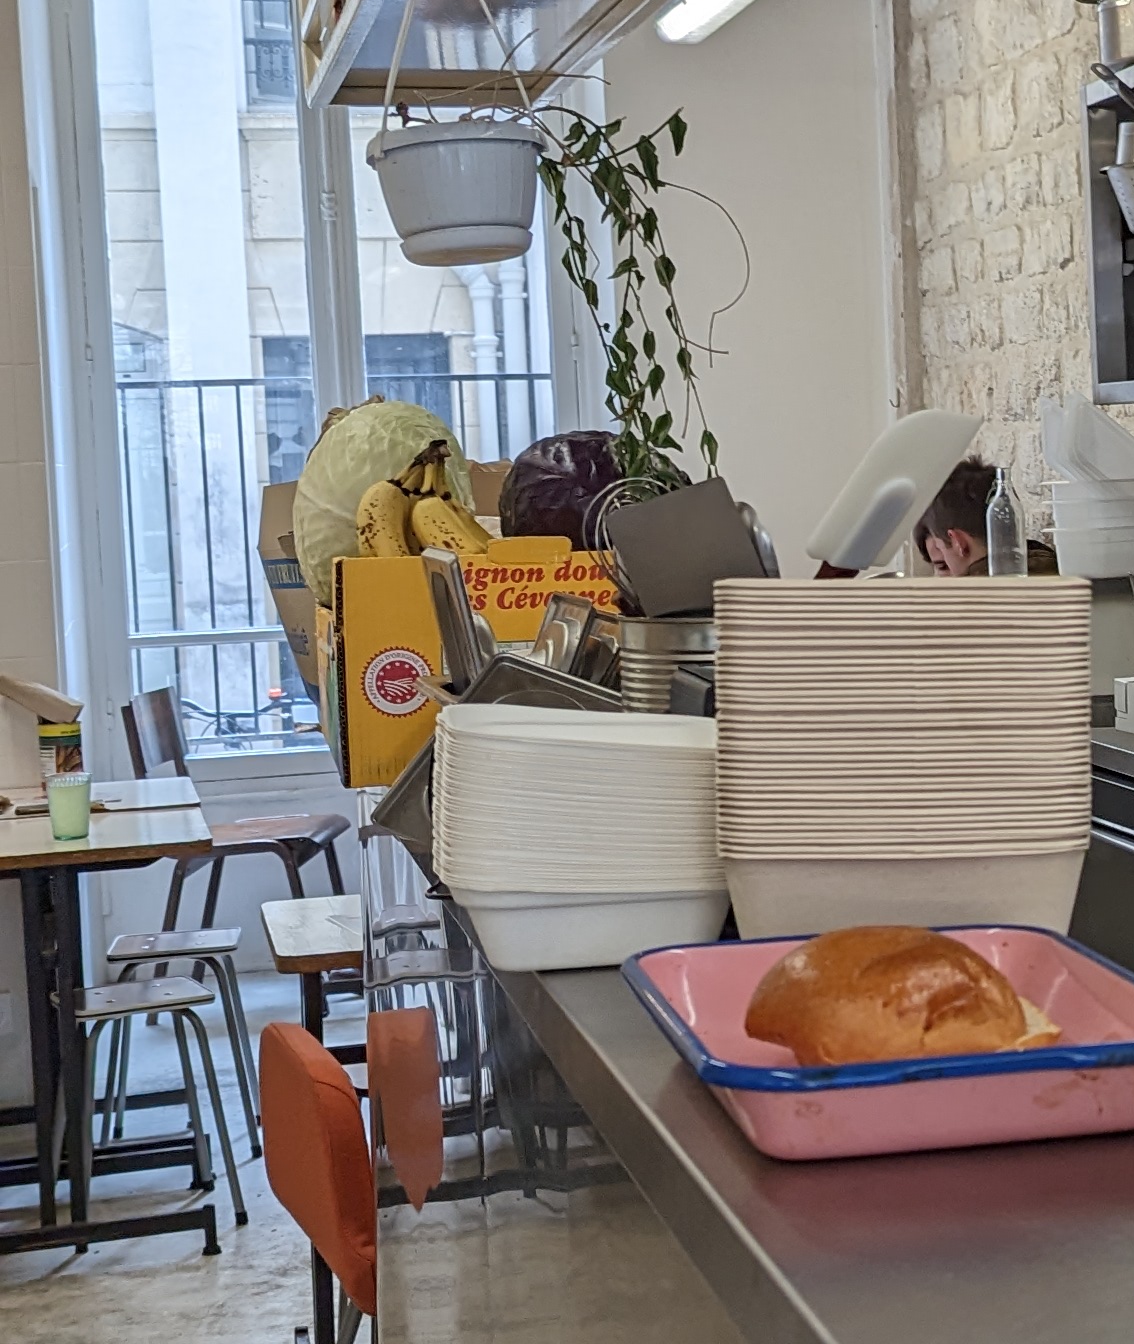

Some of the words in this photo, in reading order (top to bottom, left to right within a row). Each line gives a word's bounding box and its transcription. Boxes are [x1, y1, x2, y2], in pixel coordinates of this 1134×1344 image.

[463, 562, 545, 591] ignon
[554, 559, 609, 582] dou
[367, 657, 385, 700] APPELLATION
[385, 652, 420, 666] D'ORIGINE
